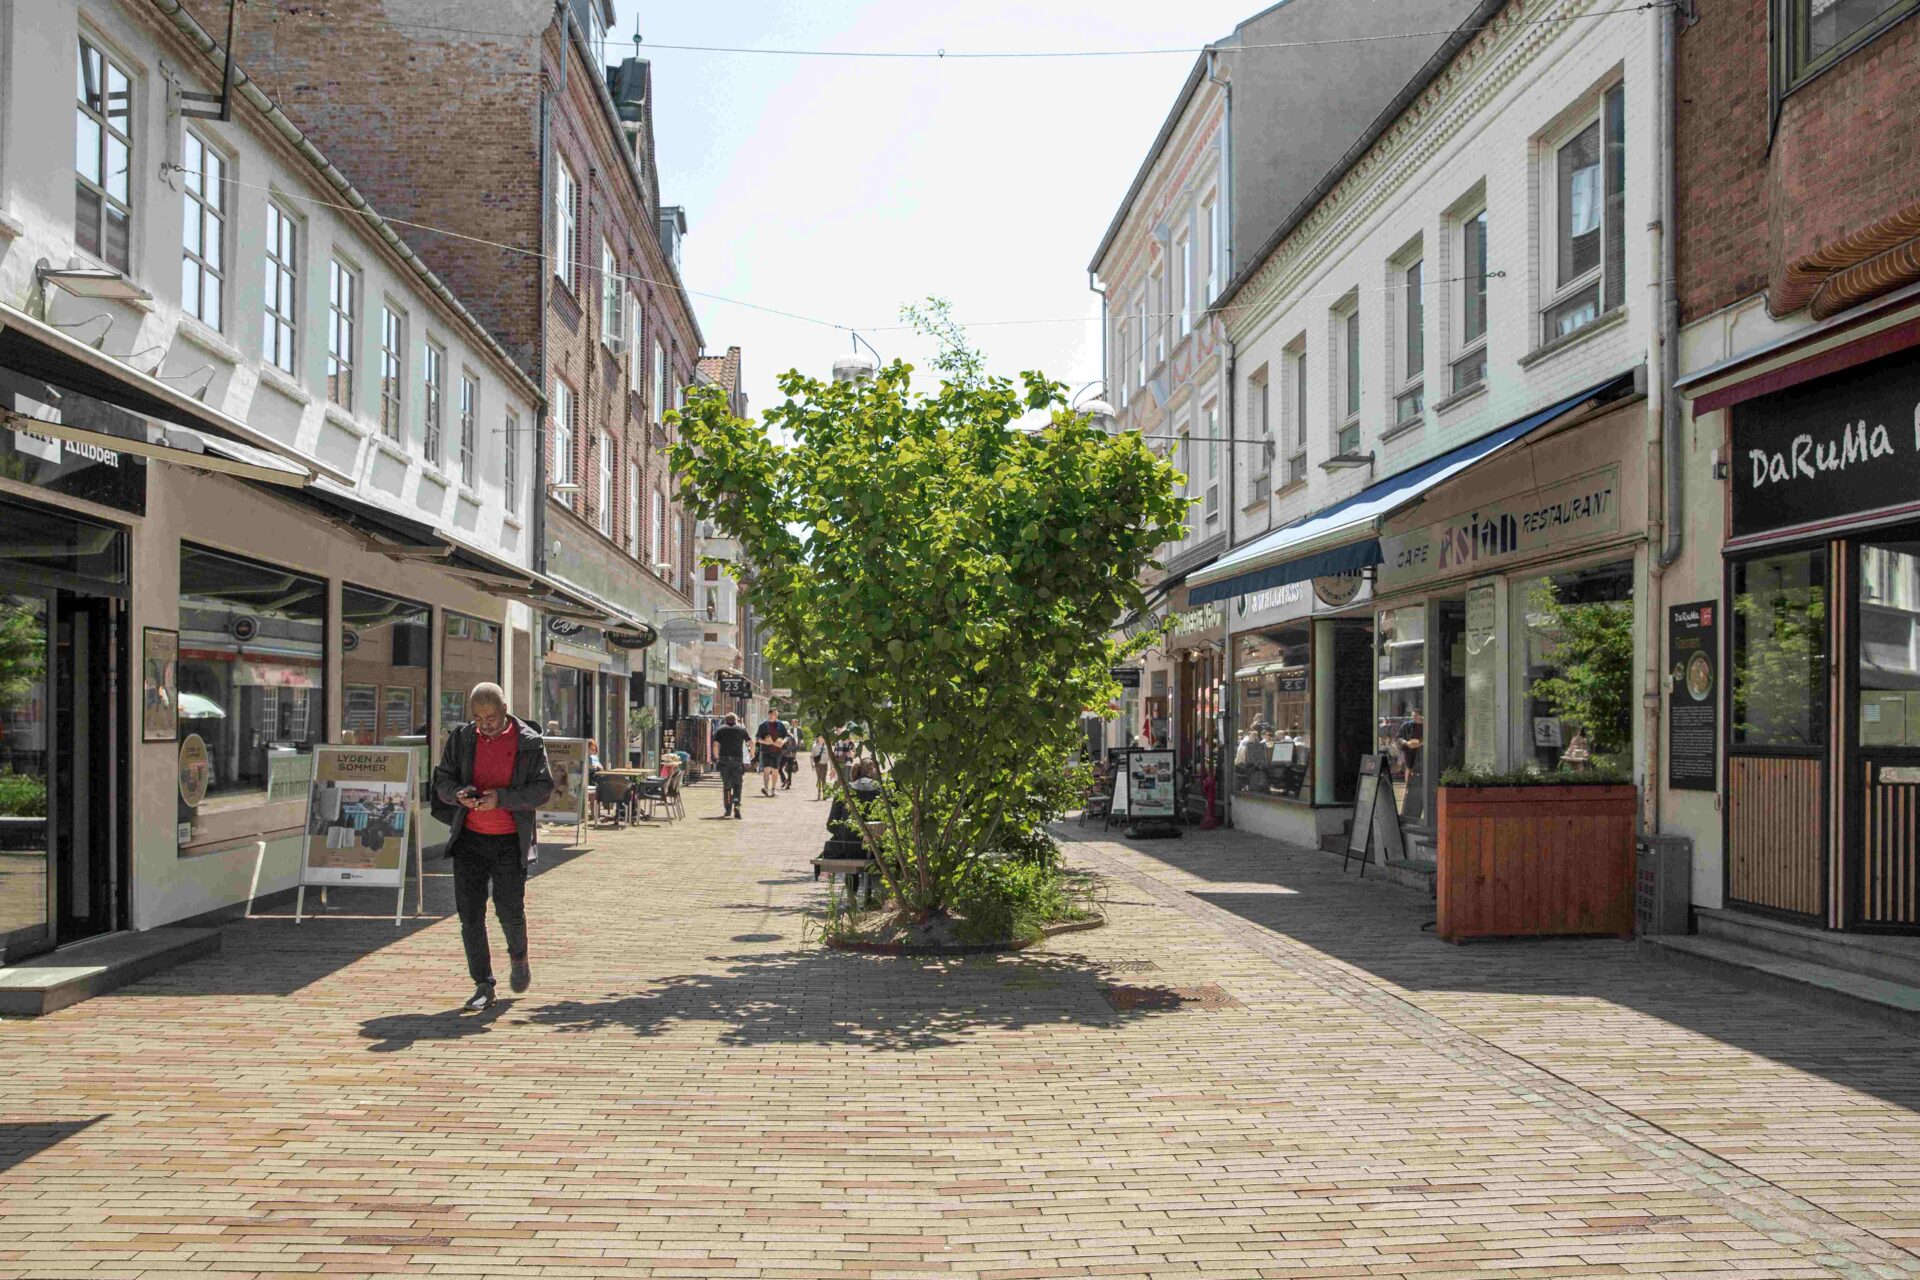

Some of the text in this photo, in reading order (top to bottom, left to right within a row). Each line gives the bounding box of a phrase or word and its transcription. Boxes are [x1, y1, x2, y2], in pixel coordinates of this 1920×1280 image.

[1522, 489, 1611, 534] RESTAURANT
[725, 682, 739, 691] 23
[338, 755, 389, 764] LYDEN AF
[338, 763, 386, 772] SOMMER
